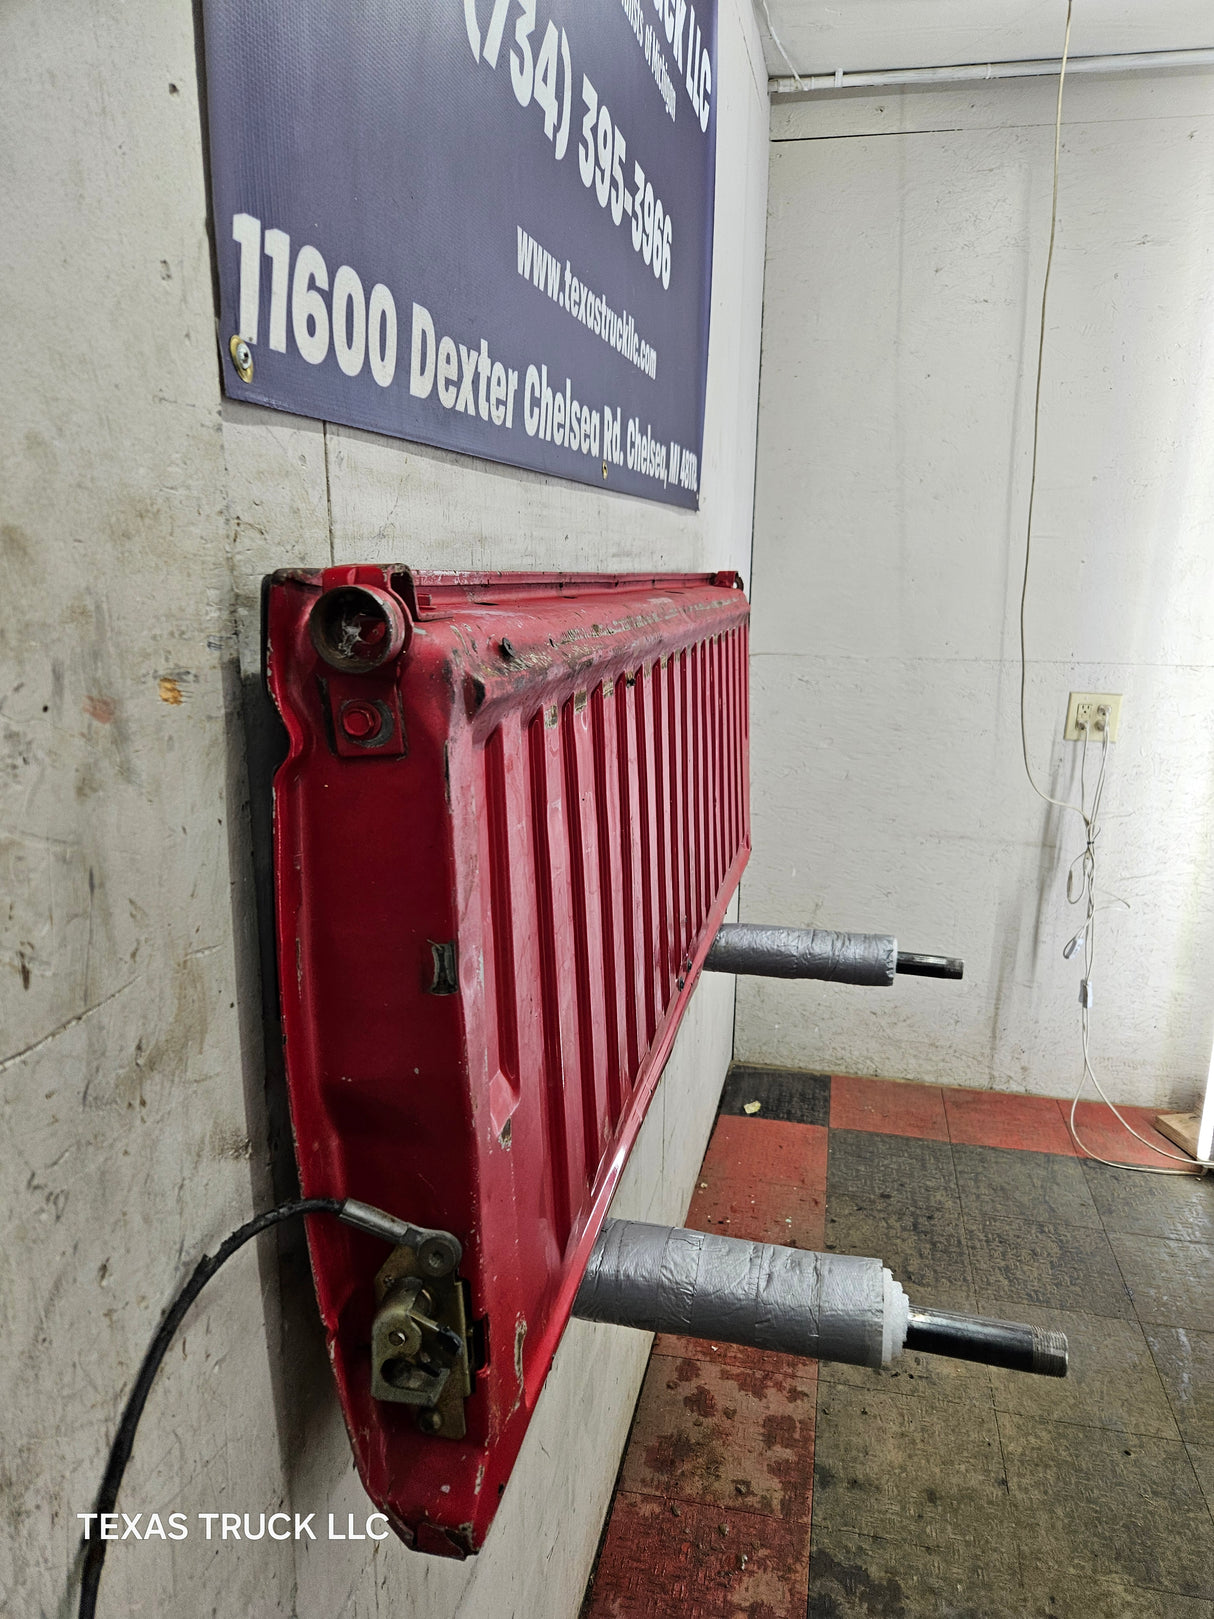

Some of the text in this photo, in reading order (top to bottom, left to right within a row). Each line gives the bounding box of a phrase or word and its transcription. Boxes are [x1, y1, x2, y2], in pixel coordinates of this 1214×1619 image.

[686, 4, 712, 133] LLC
[578, 73, 673, 290] 395-3966
[232, 212, 397, 388] 11600
[409, 301, 519, 429] Dexter
[523, 363, 600, 458] Chelsea
[603, 404, 624, 467] Rd.
[626, 416, 668, 490] Chelsea,
[668, 441, 680, 486] MI
[516, 224, 657, 380] www.texastruckllc.com
